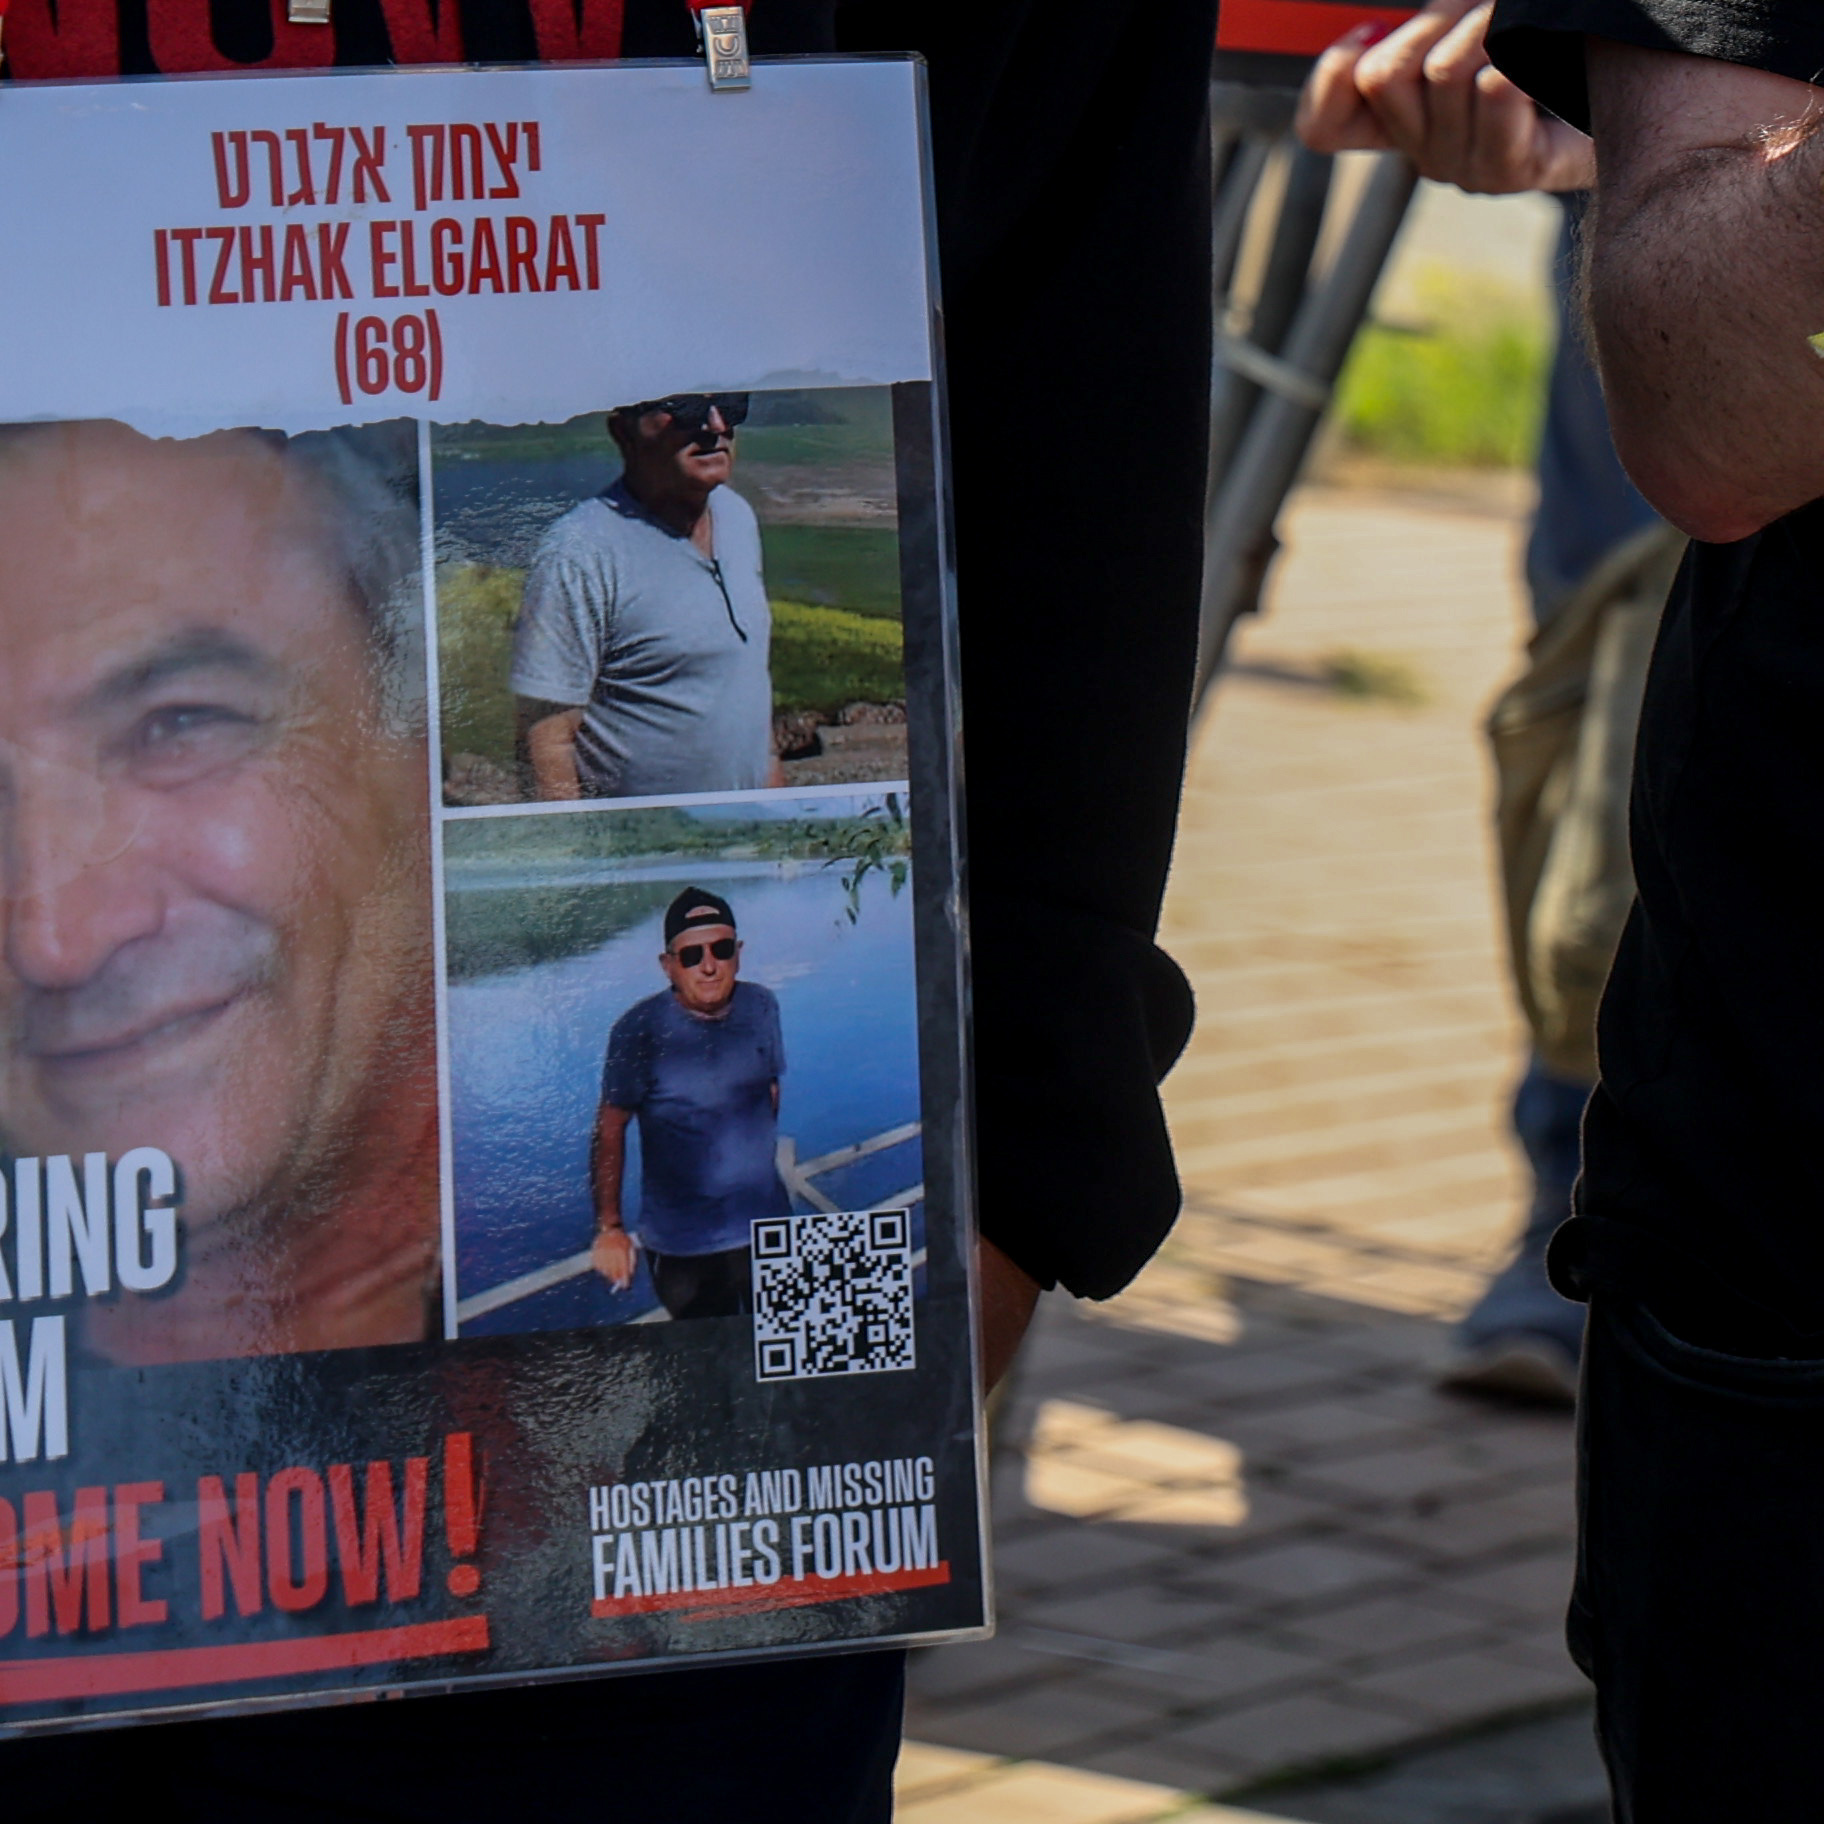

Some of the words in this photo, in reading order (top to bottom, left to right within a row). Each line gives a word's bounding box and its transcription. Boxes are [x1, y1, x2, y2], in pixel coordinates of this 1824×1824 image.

[211, 122, 391, 209] אלגרט
[409, 121, 541, 211] יצחק
[152, 224, 353, 307] ITZHAK
[373, 214, 606, 299] ELGARAT
[334, 309, 443, 405] (68)
[0, 1146, 178, 1302] ING
[197, 1432, 484, 1621] NOW!
[590, 1474, 738, 1531] HOSTAGES
[744, 1469, 801, 1515] AND
[808, 1456, 935, 1511] MISSING
[592, 1519, 782, 1601] FAMILIES
[791, 1504, 939, 1581] FORUM
